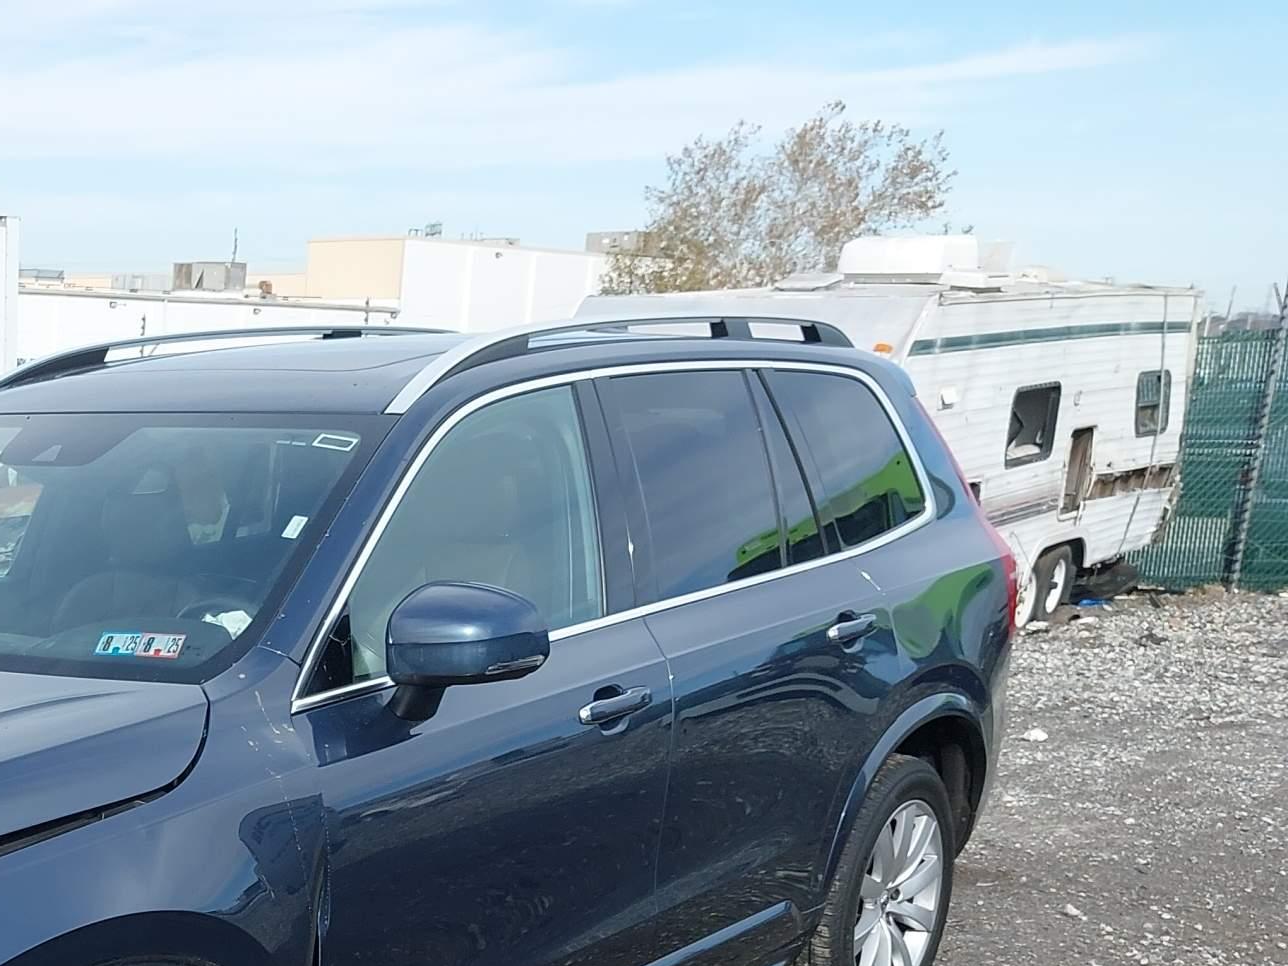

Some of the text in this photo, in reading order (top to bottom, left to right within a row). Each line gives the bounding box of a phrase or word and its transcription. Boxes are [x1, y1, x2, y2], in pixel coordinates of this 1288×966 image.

[102, 635, 140, 651] 8 25
[143, 636, 182, 653] 8 25
